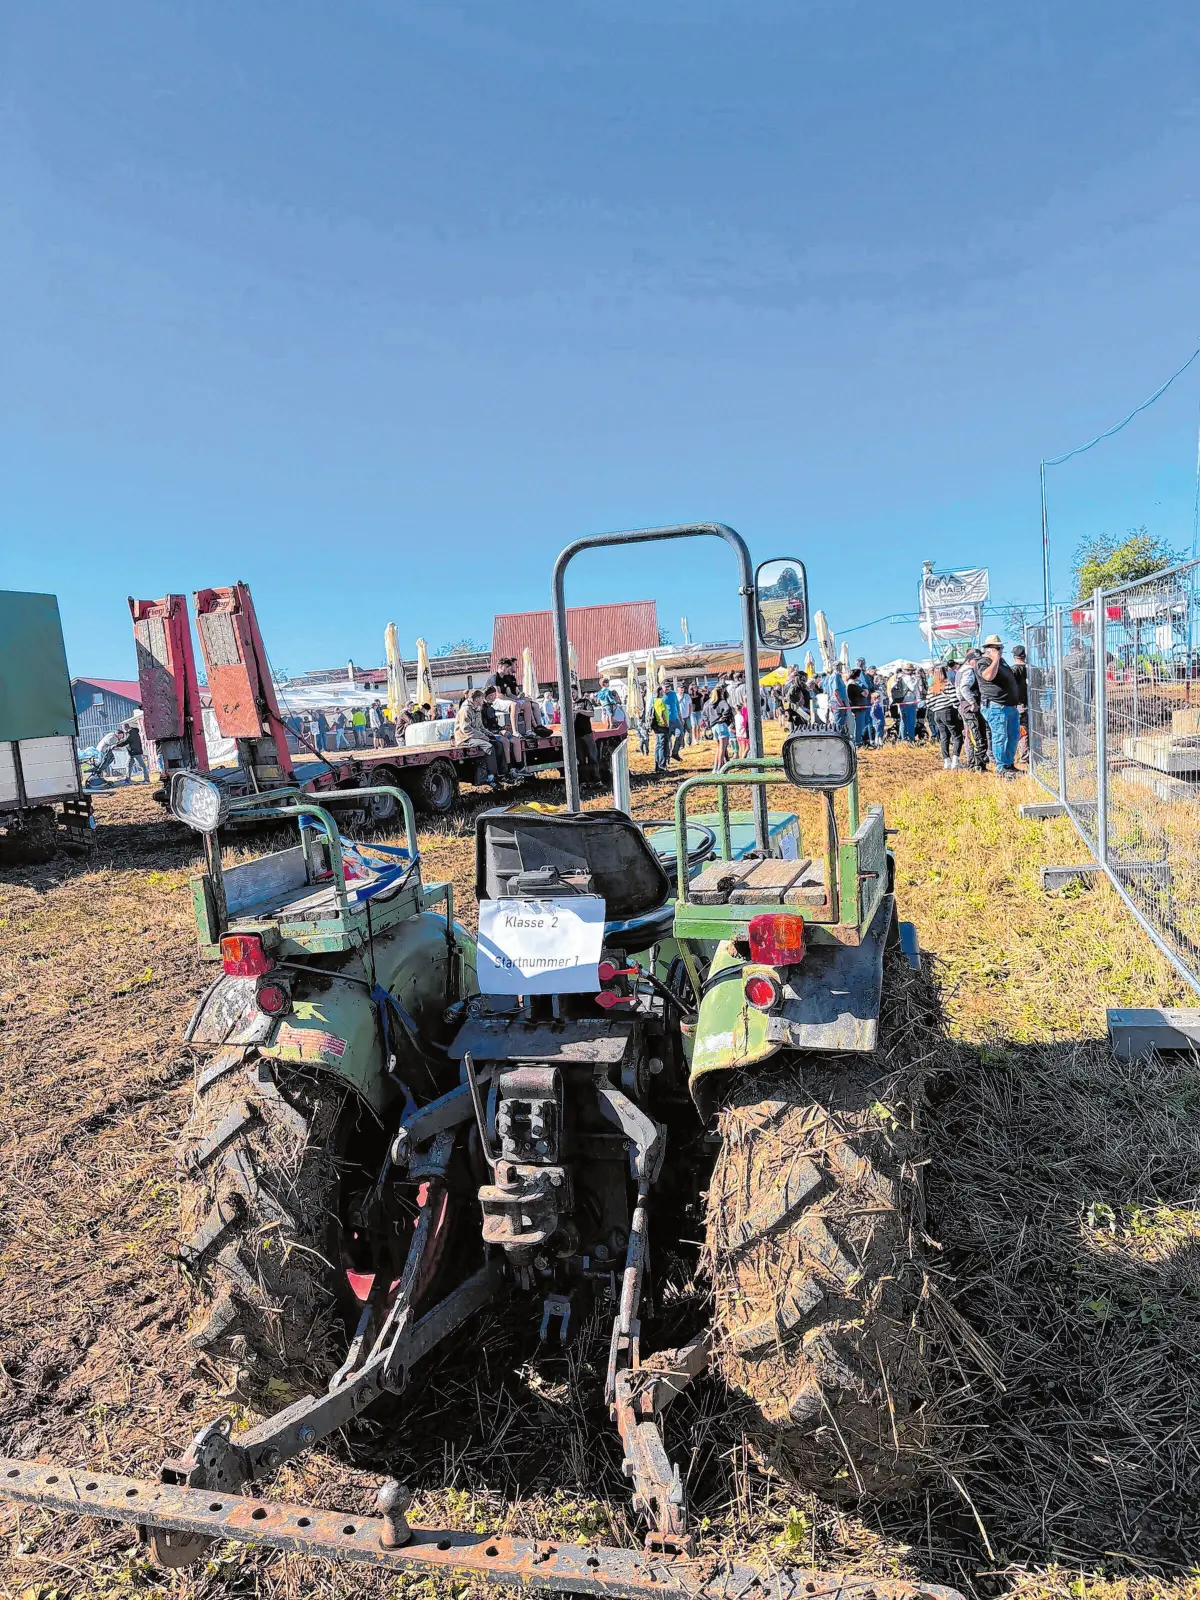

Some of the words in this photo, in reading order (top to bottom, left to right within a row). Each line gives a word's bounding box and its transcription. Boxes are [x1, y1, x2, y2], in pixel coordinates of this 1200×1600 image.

[505, 916, 544, 928] Klasse
[551, 917, 559, 928] 2
[494, 956, 571, 968] Startnummer
[574, 955, 580, 967] 1
